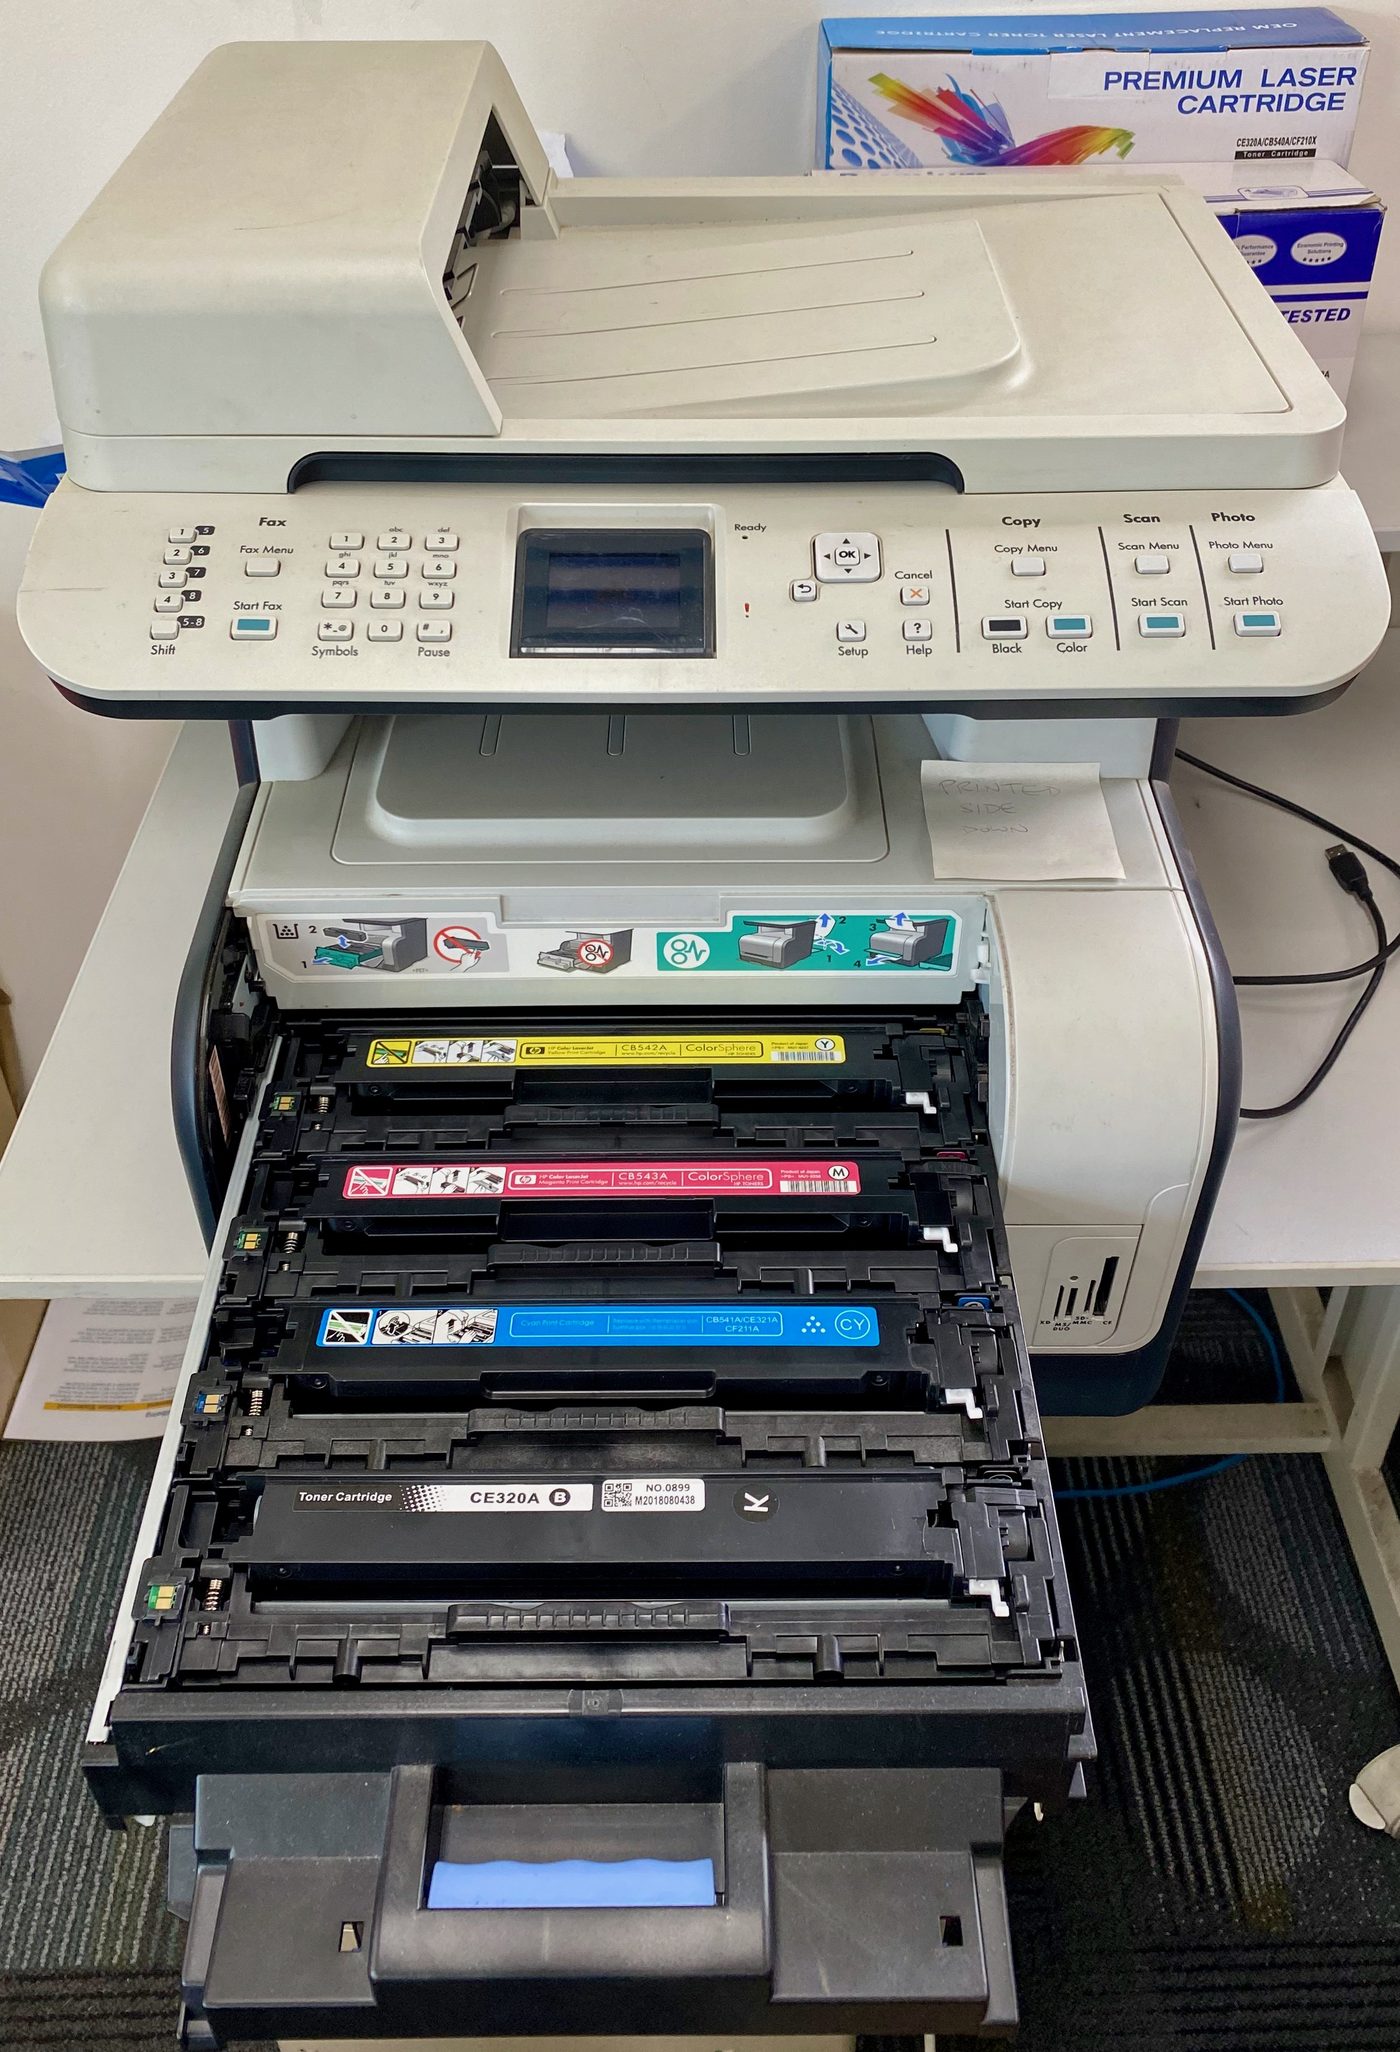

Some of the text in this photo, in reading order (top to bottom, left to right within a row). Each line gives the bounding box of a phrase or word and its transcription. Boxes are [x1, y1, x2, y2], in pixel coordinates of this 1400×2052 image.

[1252, 22, 1297, 30] OEM
[876, 29, 981, 37] CARTRIDGE
[1114, 26, 1246, 38] REPLACEMENT
[1103, 66, 1357, 91] PREMIUM LASER
[1177, 92, 1346, 115] CARTRIDGE
[1236, 136, 1317, 147] CE320A/CB540A/CF210X
[1271, 149, 1309, 158] Cartridge
[259, 517, 287, 527] Fax
[1001, 516, 1041, 528] Copy
[1123, 513, 1161, 523] Scan
[1211, 512, 1256, 523] Photo
[202, 526, 210, 534] 5
[734, 524, 767, 533] Ready
[197, 546, 205, 554] 6
[240, 545, 294, 555] Fax Menu
[994, 544, 1058, 555] Copy Menu
[1118, 542, 1180, 551] Scan Menu
[1208, 541, 1273, 550] Photo Menu
[173, 549, 180, 557] 2
[839, 550, 856, 559] OK
[168, 572, 175, 580] 3
[194, 568, 201, 576] 7
[895, 570, 933, 580] Cancel
[163, 595, 171, 604] 4
[189, 591, 197, 600] 8
[233, 601, 282, 611] Start Fax
[1004, 599, 1063, 610] Start Copy
[1131, 597, 1188, 607] Start Scan
[1223, 596, 1284, 606] Start Photo
[182, 617, 203, 626] 5-8
[381, 624, 388, 632] 0
[913, 623, 921, 633] ?
[151, 644, 176, 655] Shift
[312, 645, 358, 658] Symbols
[417, 647, 450, 657] Pause
[838, 647, 869, 658] Setup
[906, 645, 932, 657] Help
[992, 643, 1022, 654] Black
[1056, 642, 1088, 653] Color
[938, 779, 1062, 797] PRINTED
[960, 802, 1017, 815] SIDE
[961, 824, 1029, 833] DOWN
[839, 916, 847, 924] 2
[308, 926, 317, 934] 2
[869, 923, 877, 931] 3
[301, 961, 307, 969] 1
[853, 960, 861, 968] 4
[685, 1044, 756, 1053] ColorSphere
[619, 1172, 668, 1180] CB543A
[688, 1171, 764, 1183] ColorSphere
[832, 1168, 845, 1176] M
[520, 1319, 541, 1327] Cyan
[559, 1319, 594, 1327] Cartridge
[706, 1316, 778, 1324] CB541A/CE321A
[840, 1319, 865, 1331] CY
[646, 1484, 690, 1492] NO.0899
[299, 1492, 392, 1504] Toner Cartridge
[470, 1492, 540, 1504] CE320A
[635, 1495, 695, 1506] M2018080438
[743, 1492, 769, 1512] K
